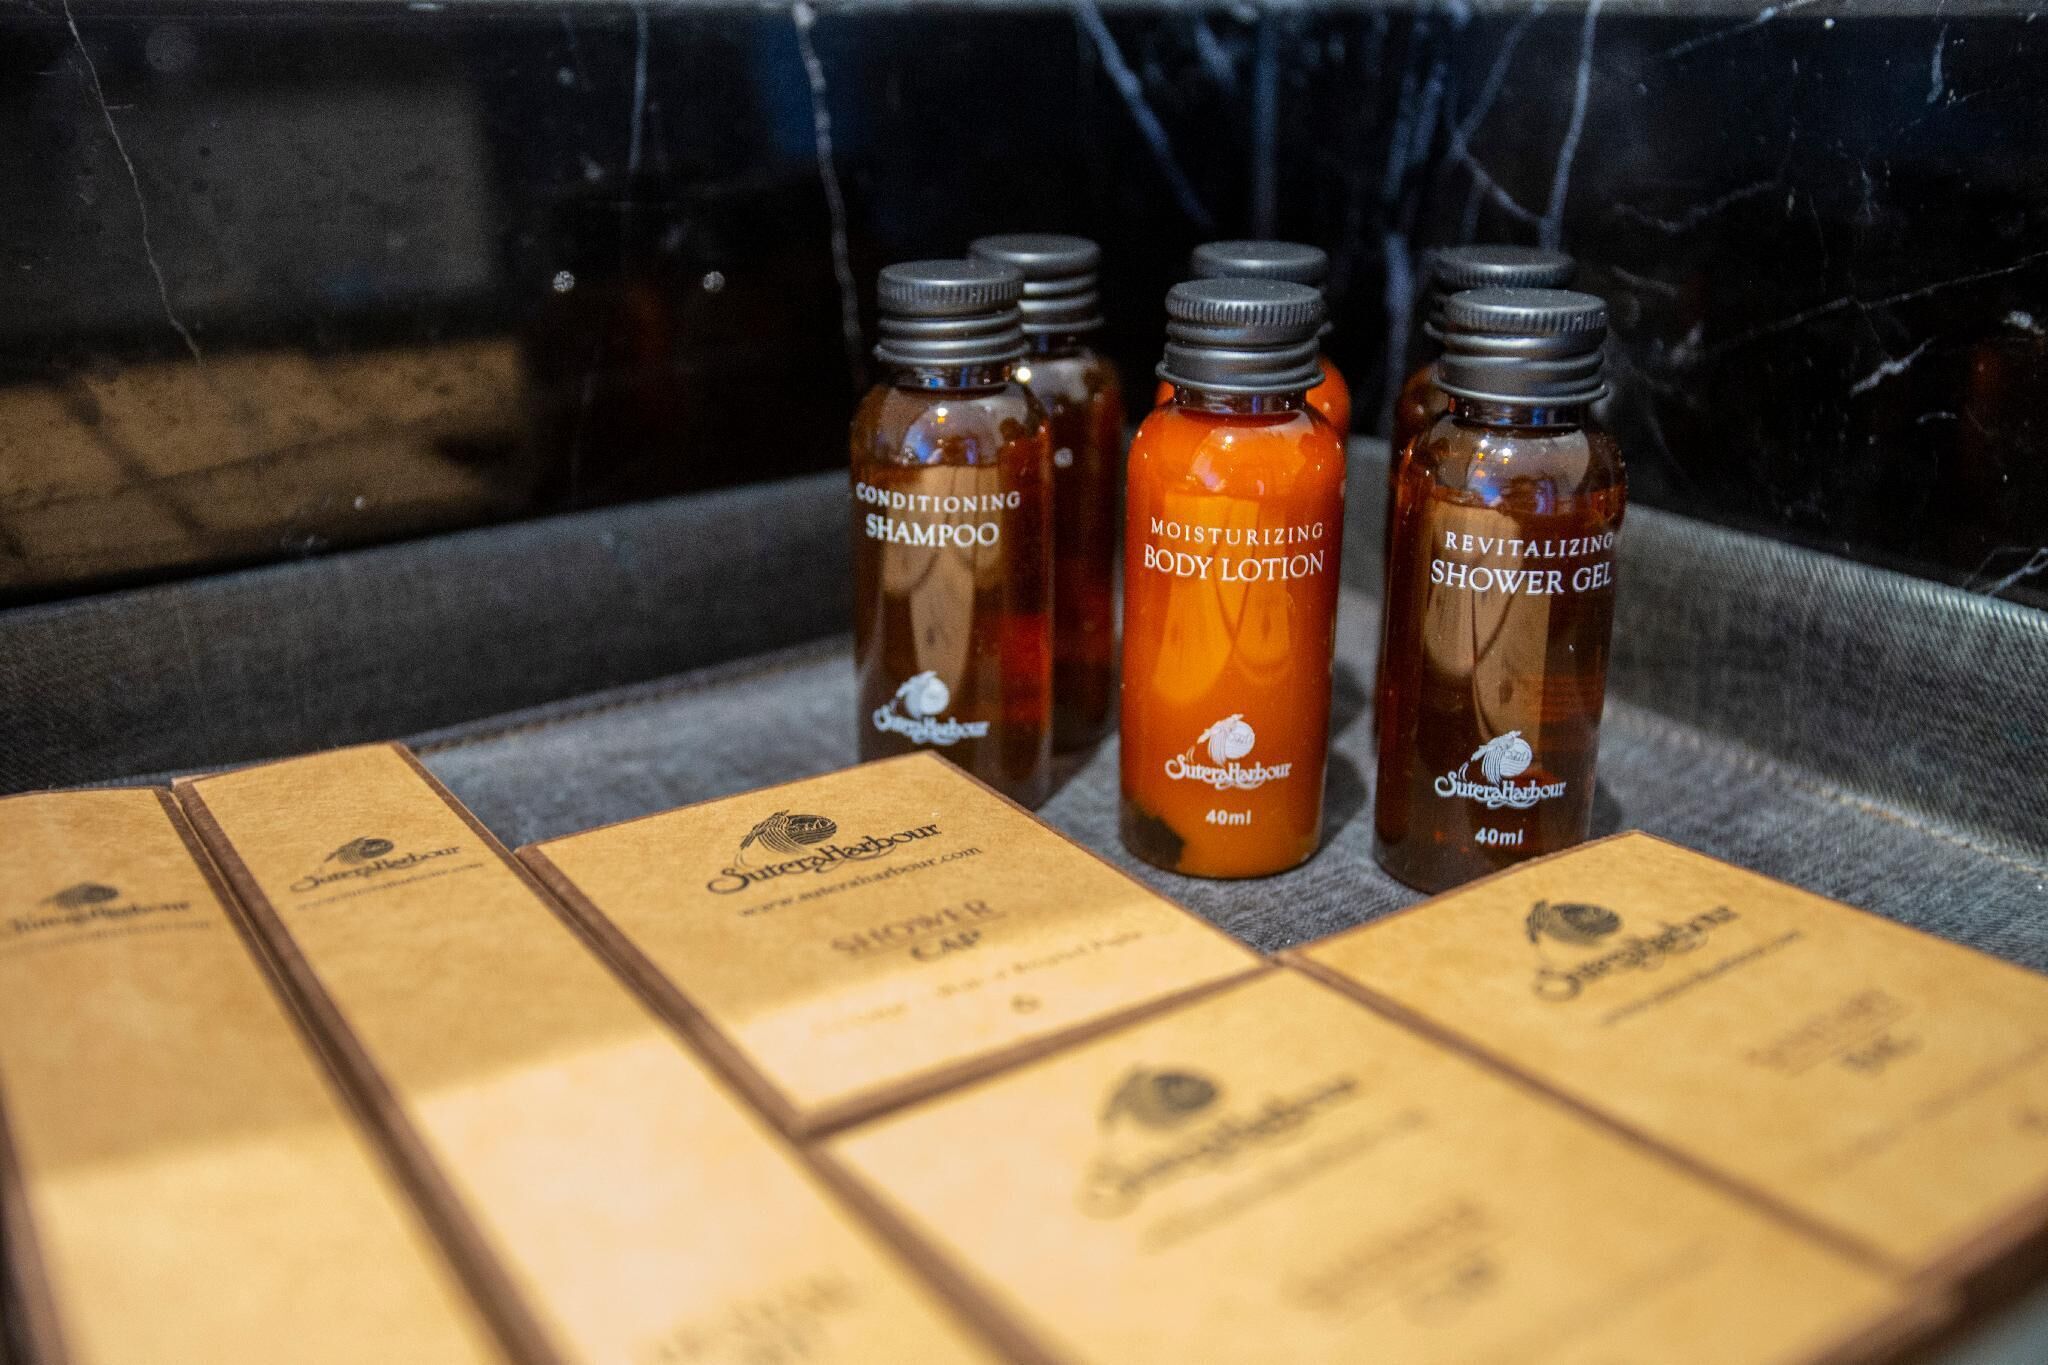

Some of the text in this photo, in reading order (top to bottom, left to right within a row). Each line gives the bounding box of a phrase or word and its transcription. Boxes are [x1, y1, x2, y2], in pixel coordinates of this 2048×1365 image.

[855, 482, 1021, 513] CONDITIONING
[865, 513, 1000, 548] SHAMPOO
[1151, 517, 1324, 546] MOISTURIZING
[1444, 530, 1615, 558] REVITALIZING
[1144, 543, 1325, 582] BODY LOTION
[1430, 559, 1612, 595] SHOWER GEL
[1205, 809, 1252, 826] 40ml
[1474, 827, 1524, 846] 40ml
